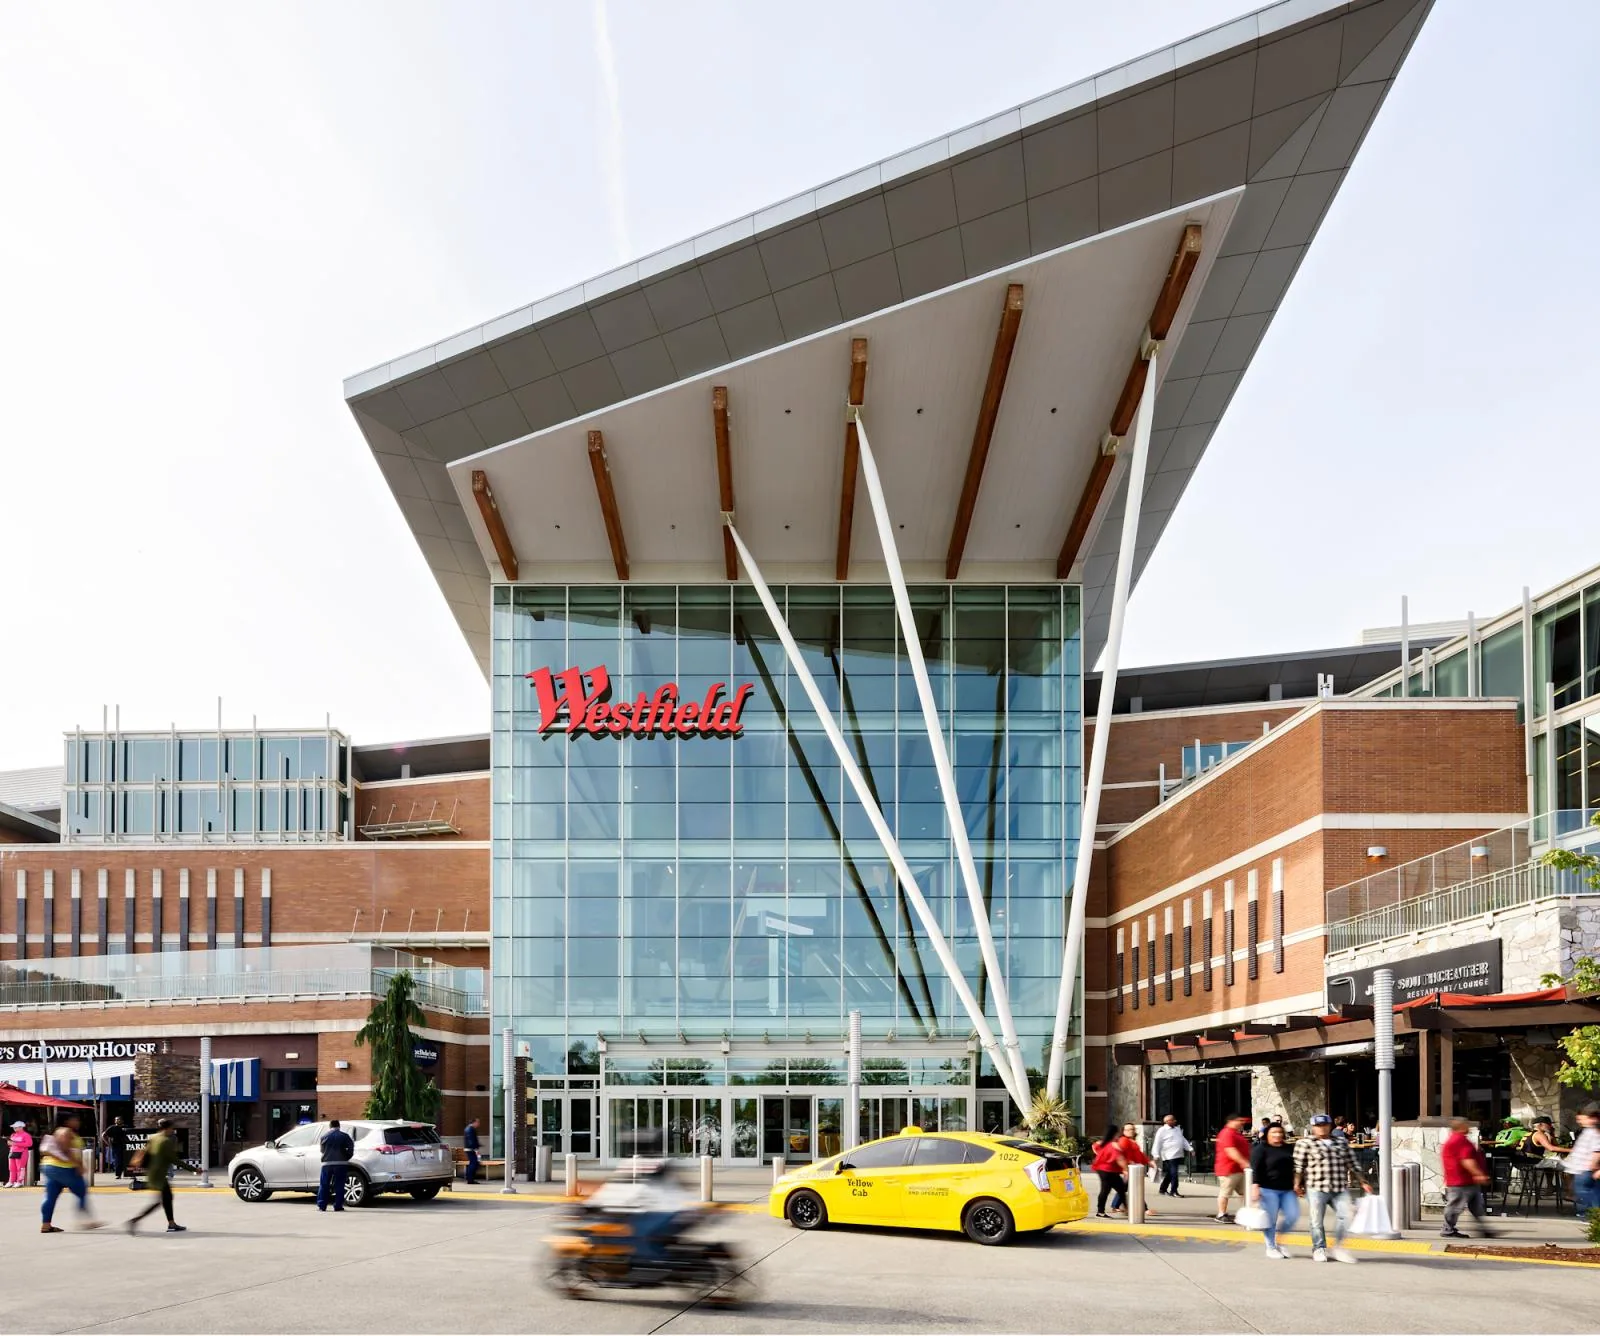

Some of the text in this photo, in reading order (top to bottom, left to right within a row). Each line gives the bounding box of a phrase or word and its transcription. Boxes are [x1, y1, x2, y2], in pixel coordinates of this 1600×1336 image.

[525, 664, 754, 734] Westfield
[999, 1153, 1019, 1161] 1022
[847, 1178, 874, 1188] Yellow
[852, 1189, 868, 1197] Cab
